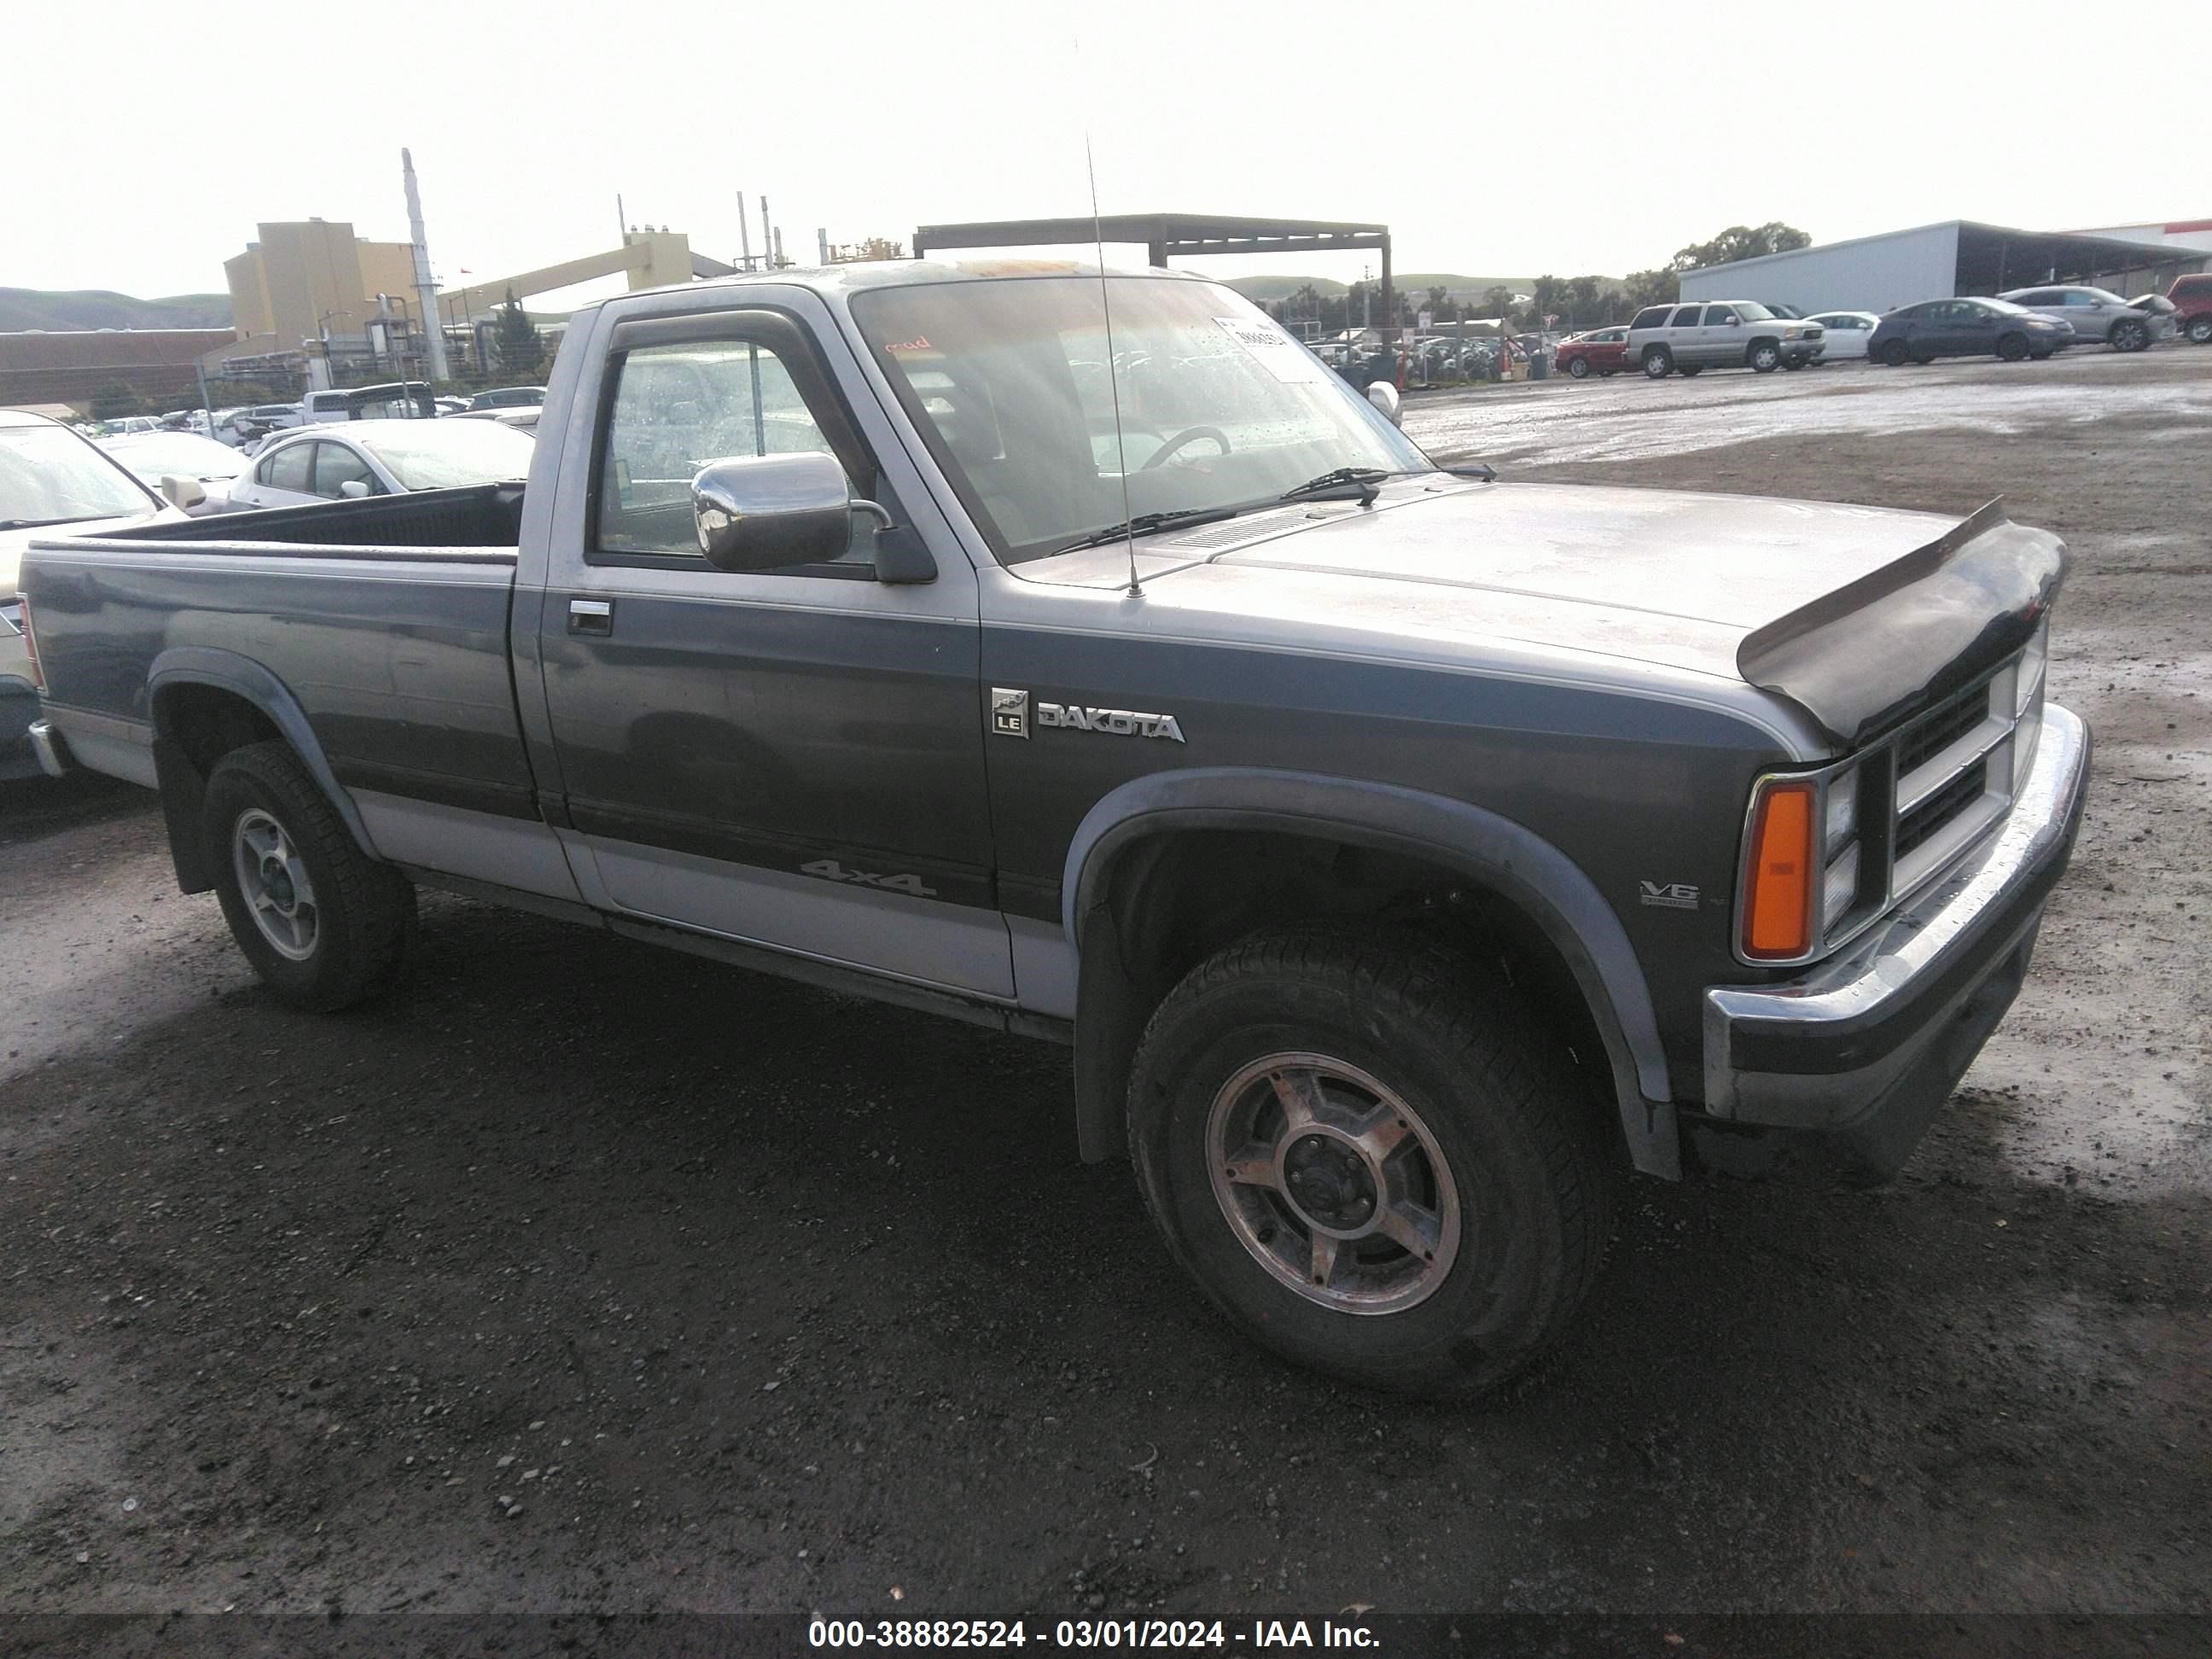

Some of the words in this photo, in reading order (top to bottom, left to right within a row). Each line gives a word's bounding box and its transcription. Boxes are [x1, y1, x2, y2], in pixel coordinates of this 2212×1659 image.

[998, 716, 1020, 731] LE
[1038, 702, 1186, 743] DAKOTA
[1640, 880, 1700, 899] V6
